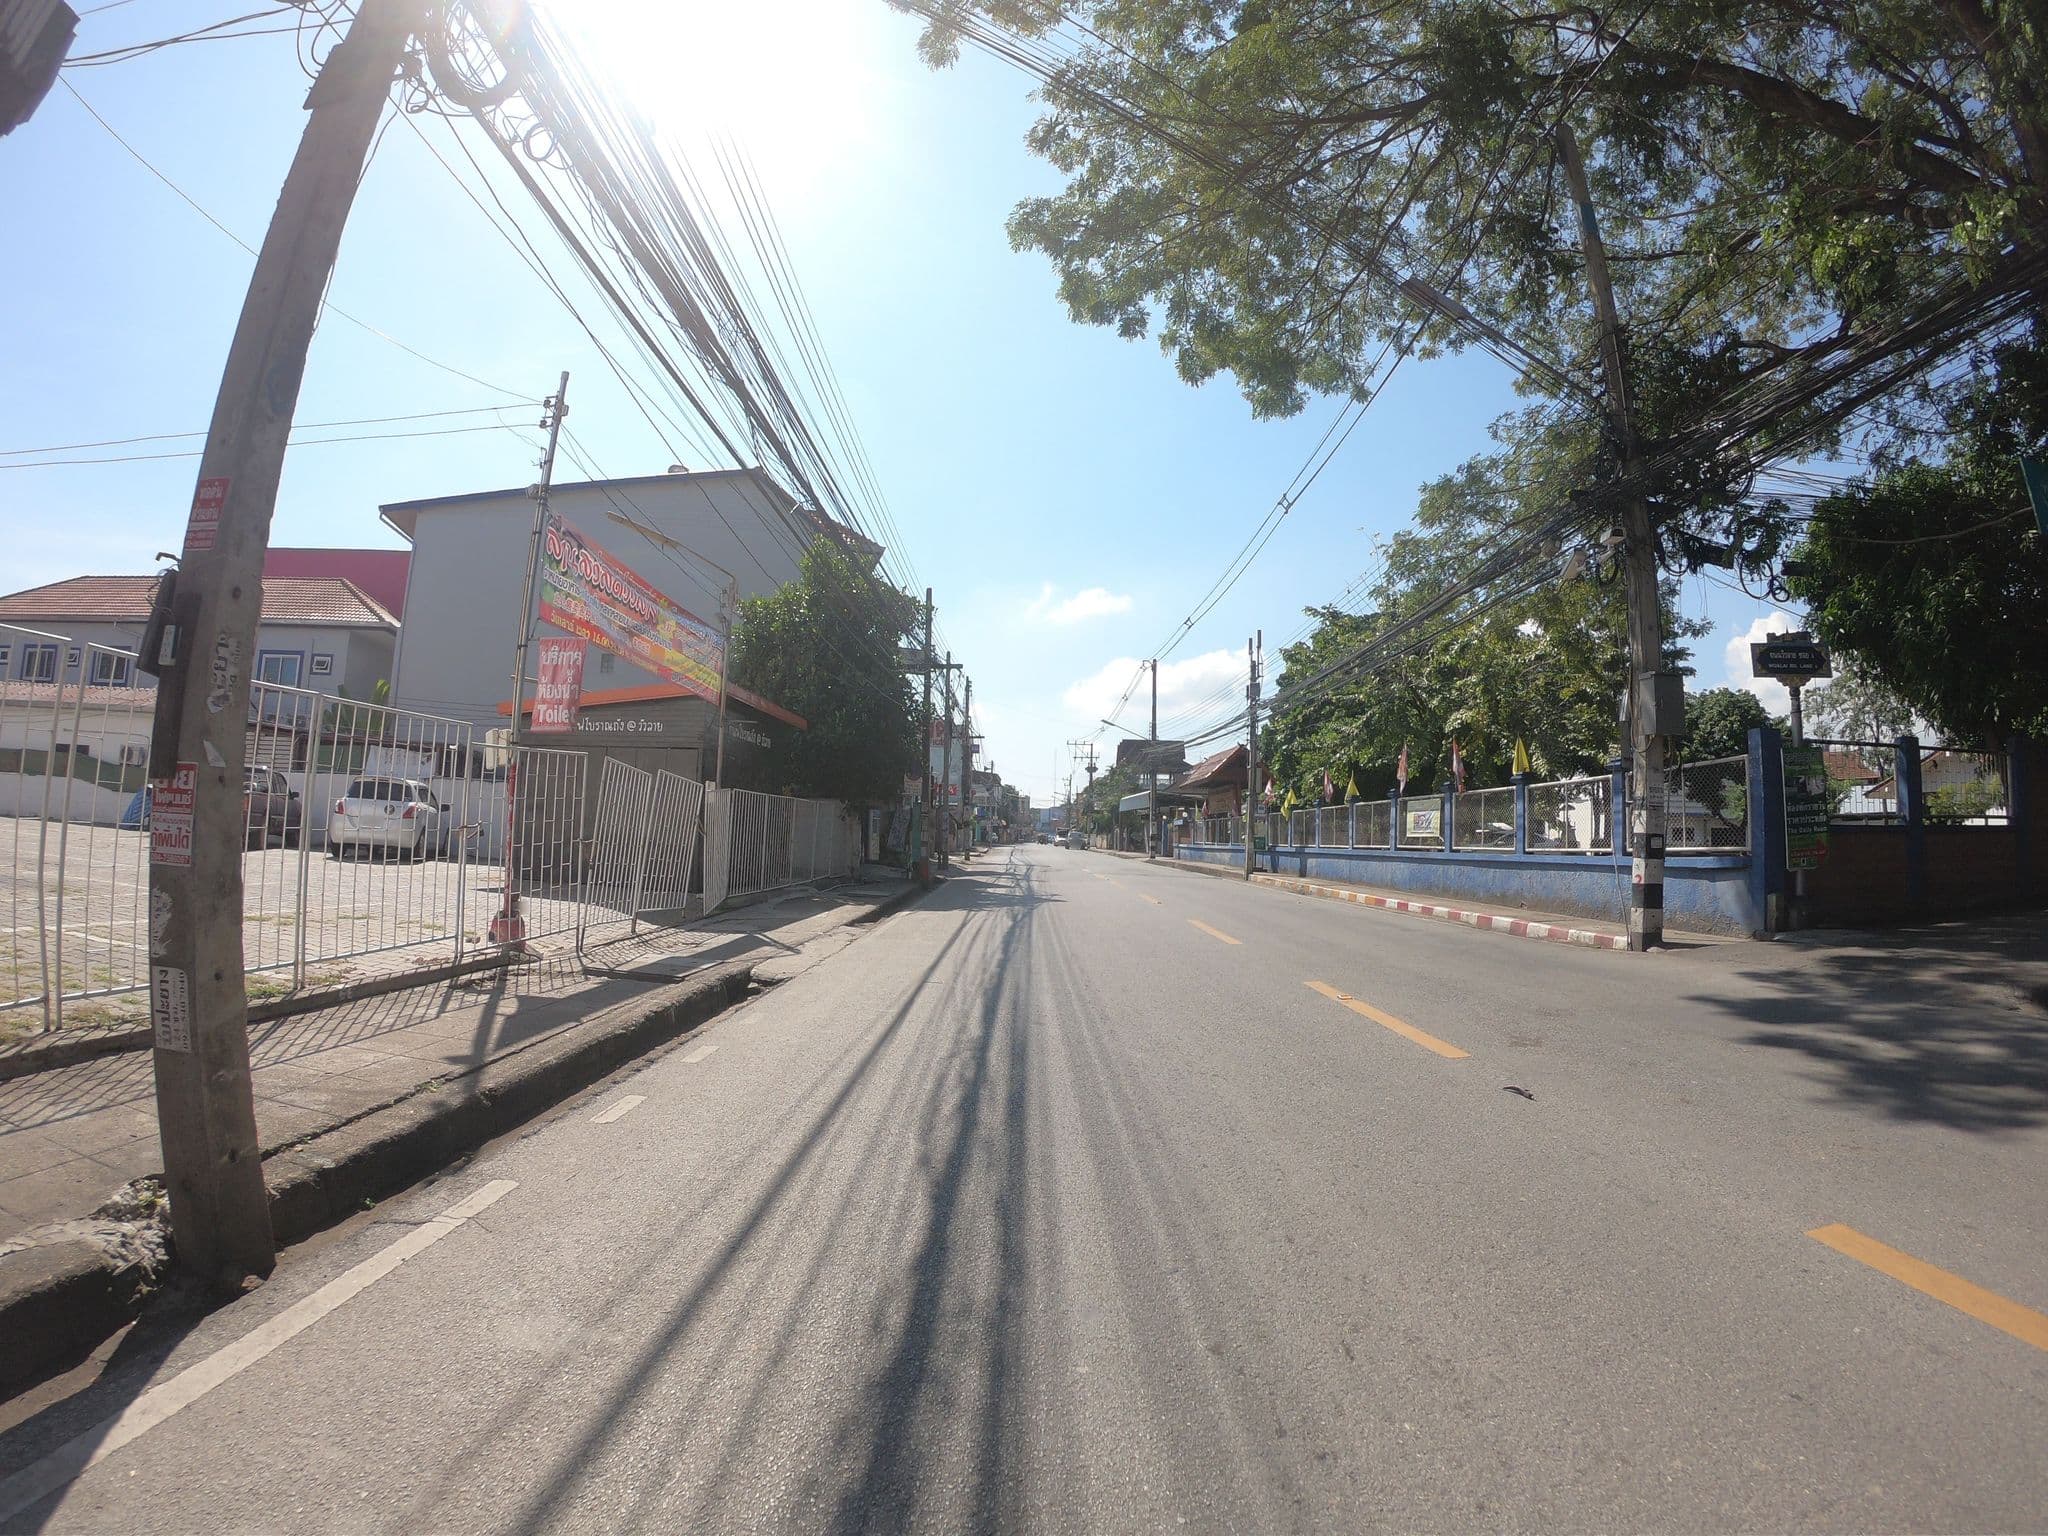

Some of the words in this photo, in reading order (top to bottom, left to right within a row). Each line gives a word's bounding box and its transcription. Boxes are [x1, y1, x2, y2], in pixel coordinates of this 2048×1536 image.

[542, 646, 582, 664] บริการ
[538, 669, 579, 699] ห้องน้ำ
[538, 704, 576, 723] Toilet
